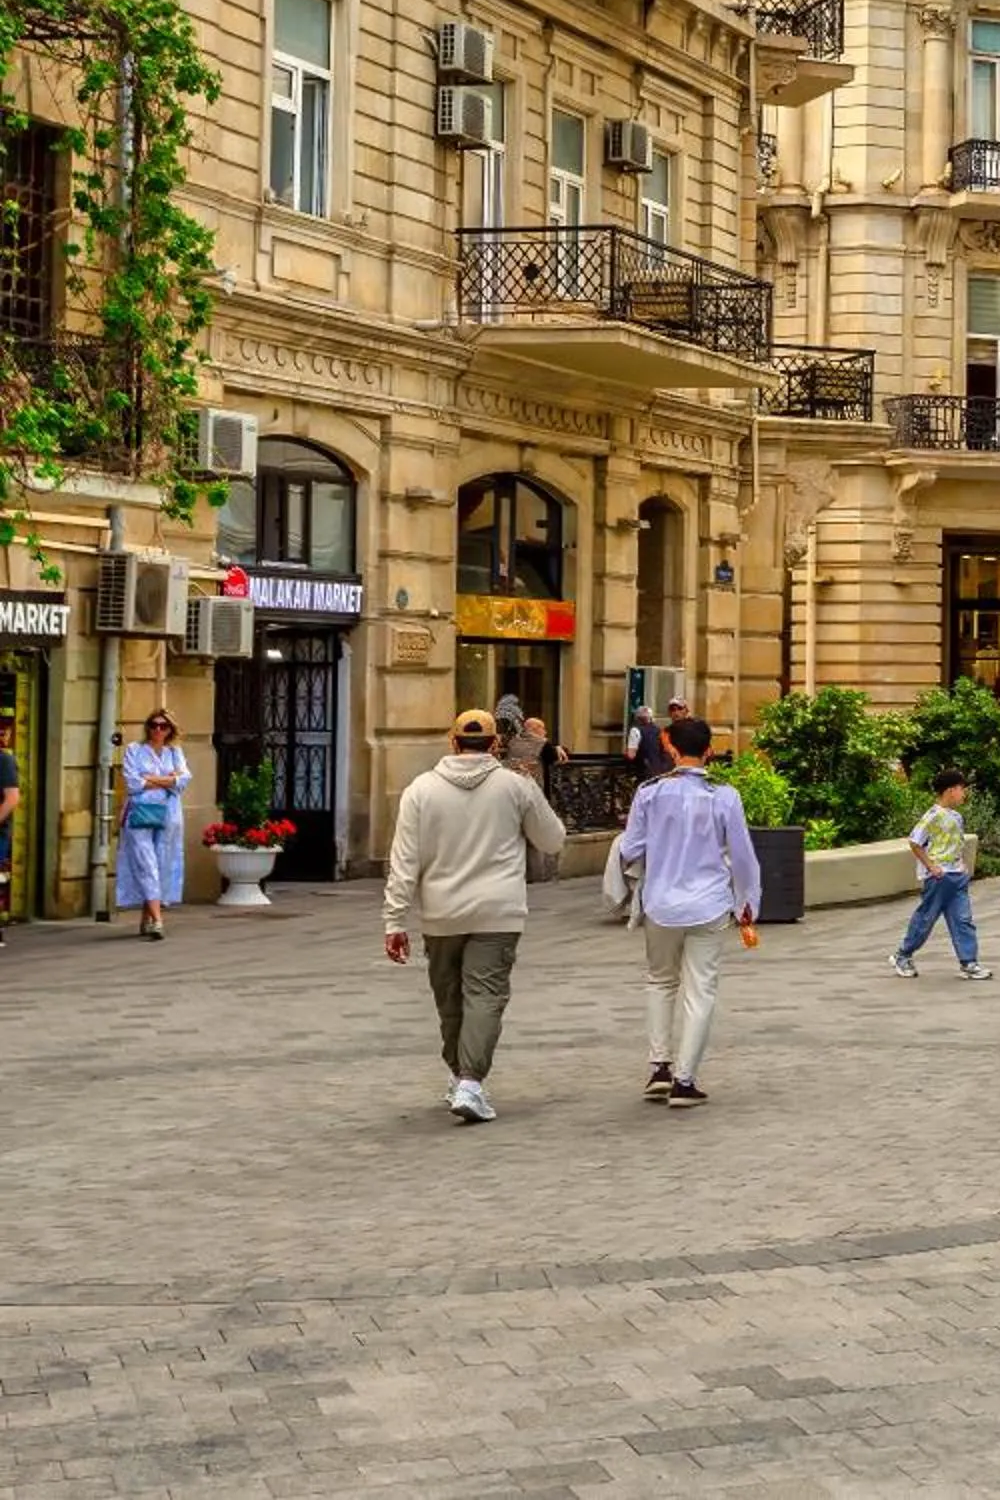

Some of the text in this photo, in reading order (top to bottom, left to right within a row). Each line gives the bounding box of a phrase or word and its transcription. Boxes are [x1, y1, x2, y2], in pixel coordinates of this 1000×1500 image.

[250, 576, 363, 613] MALAKAN MARKET
[0, 601, 71, 635] MARKET
